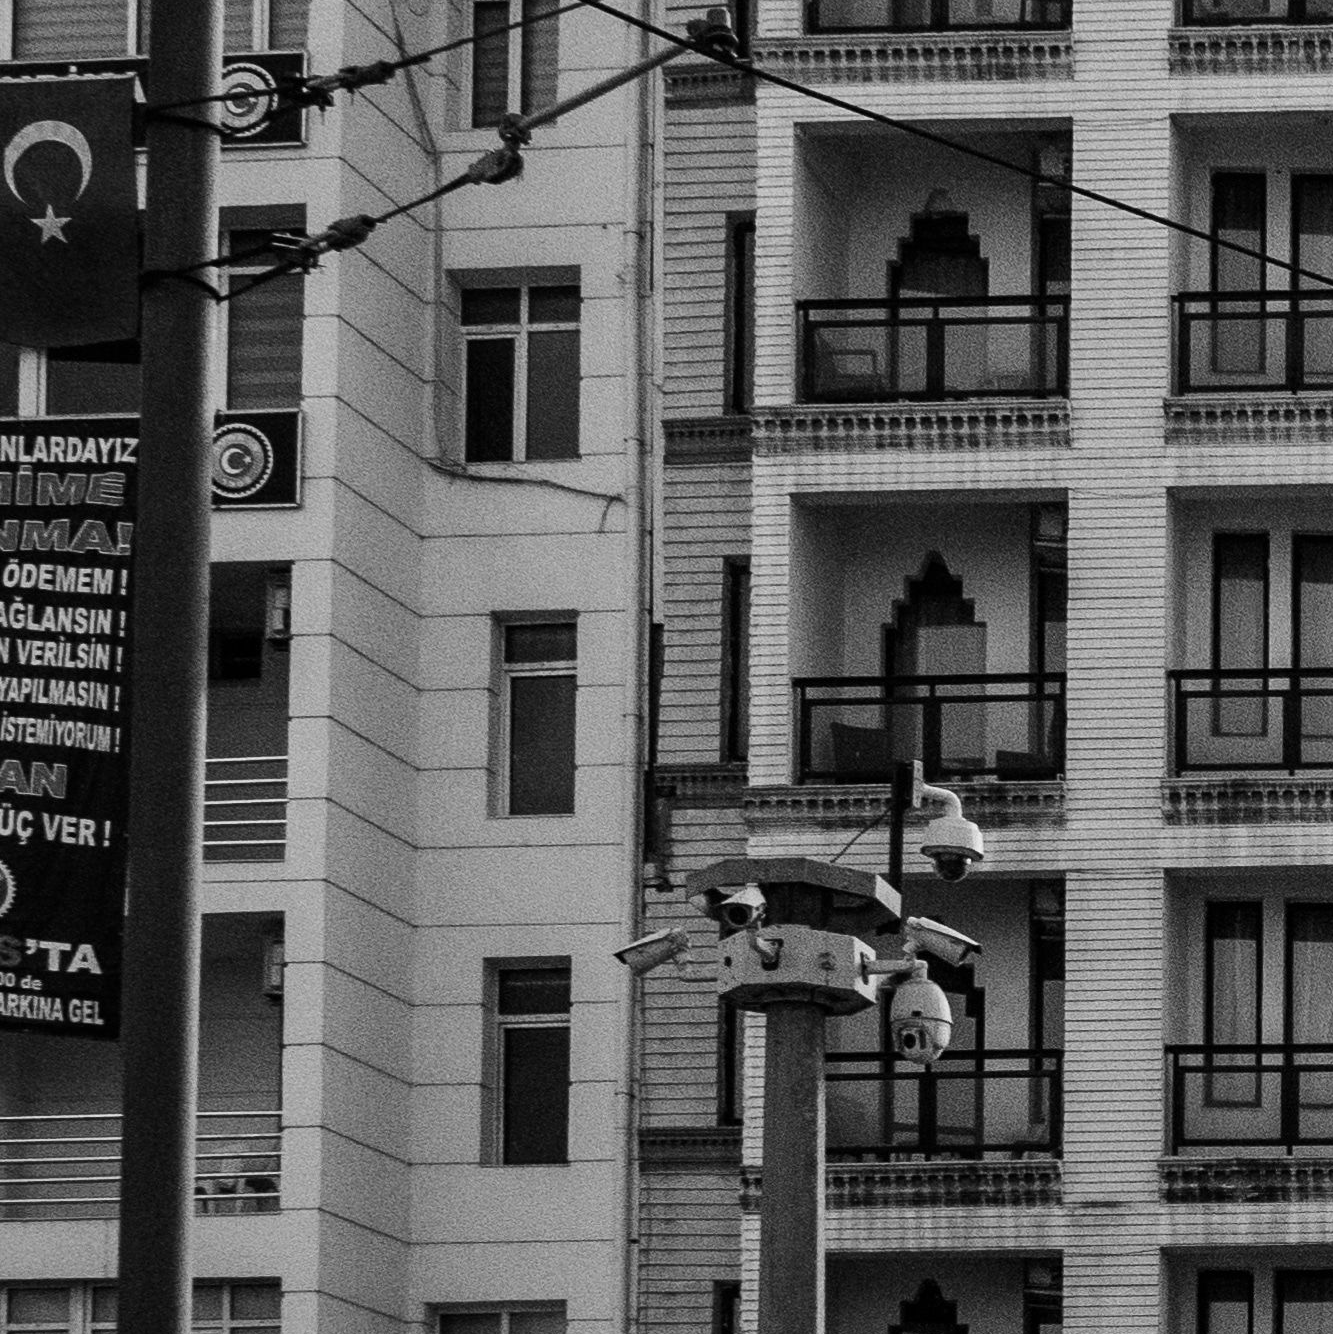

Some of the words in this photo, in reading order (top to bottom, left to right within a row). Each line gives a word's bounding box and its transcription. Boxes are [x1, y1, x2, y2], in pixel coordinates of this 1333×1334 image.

[3, 557, 114, 595] ÖDEMEM
[16, 634, 110, 670] VERİLSİN
[42, 812, 96, 847] VER
[20, 975, 43, 990] de
[68, 998, 105, 1025] GEL
